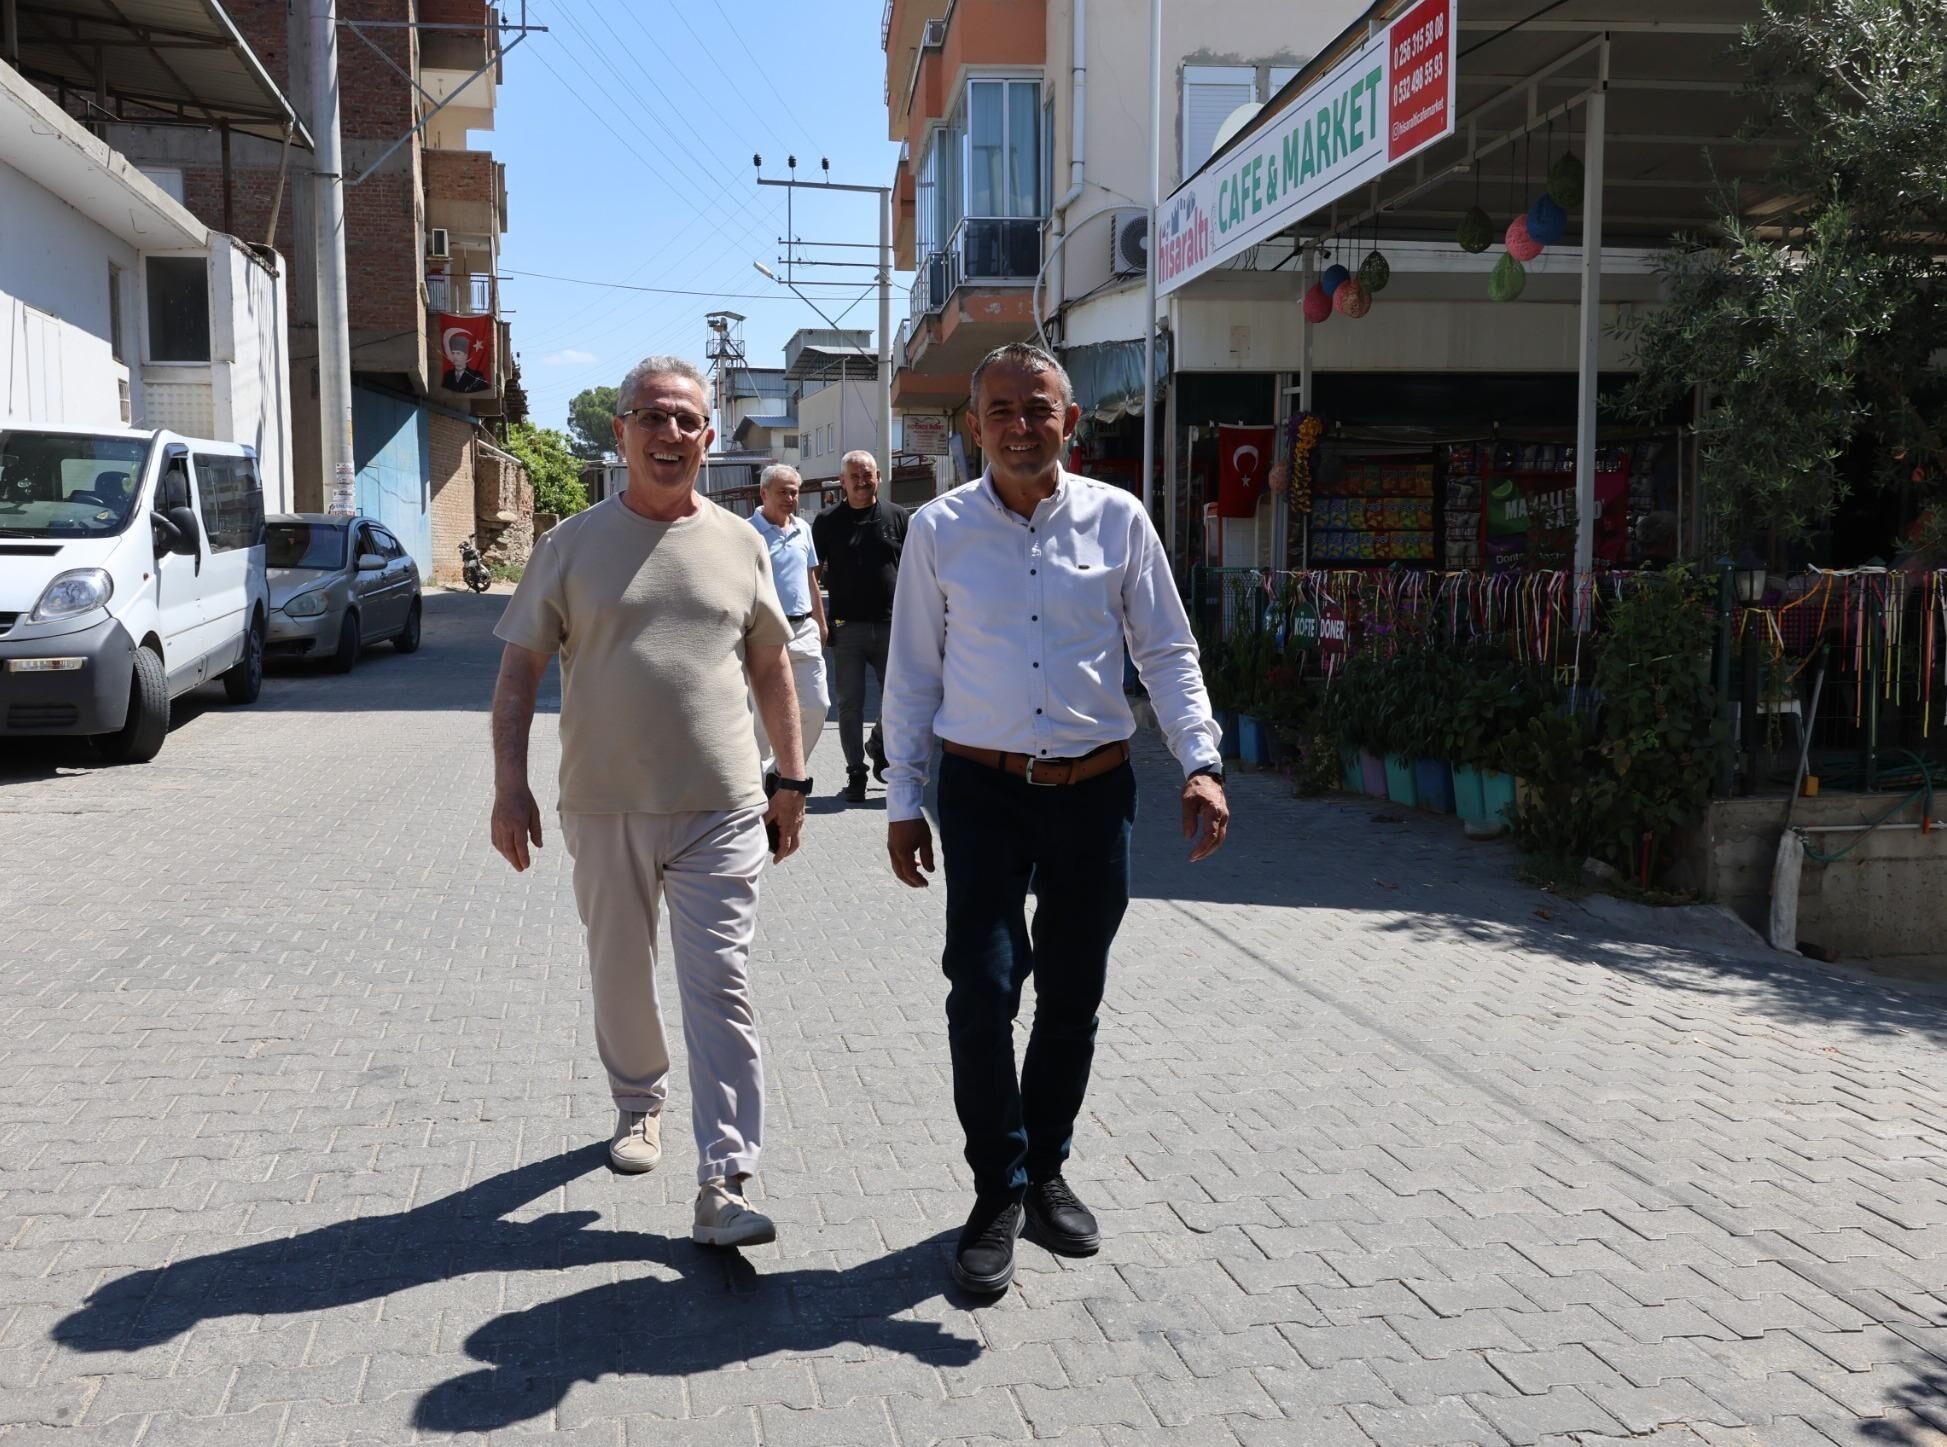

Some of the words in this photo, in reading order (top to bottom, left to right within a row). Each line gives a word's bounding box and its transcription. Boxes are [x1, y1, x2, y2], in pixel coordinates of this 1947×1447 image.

[1394, 47, 1399, 70] 0
[1399, 37, 1411, 66] 256
[1412, 27, 1424, 58] 315
[1425, 20, 1434, 48] 58
[1393, 84, 1398, 107] 0
[1399, 75, 1411, 104] 532
[1424, 58, 1433, 86] 55
[1434, 51, 1443, 78] 93
[1218, 153, 1263, 234] CAFE
[1266, 154, 1278, 205] &
[1282, 64, 1382, 196] MARKET
[1319, 612, 1345, 640] DÖNER
